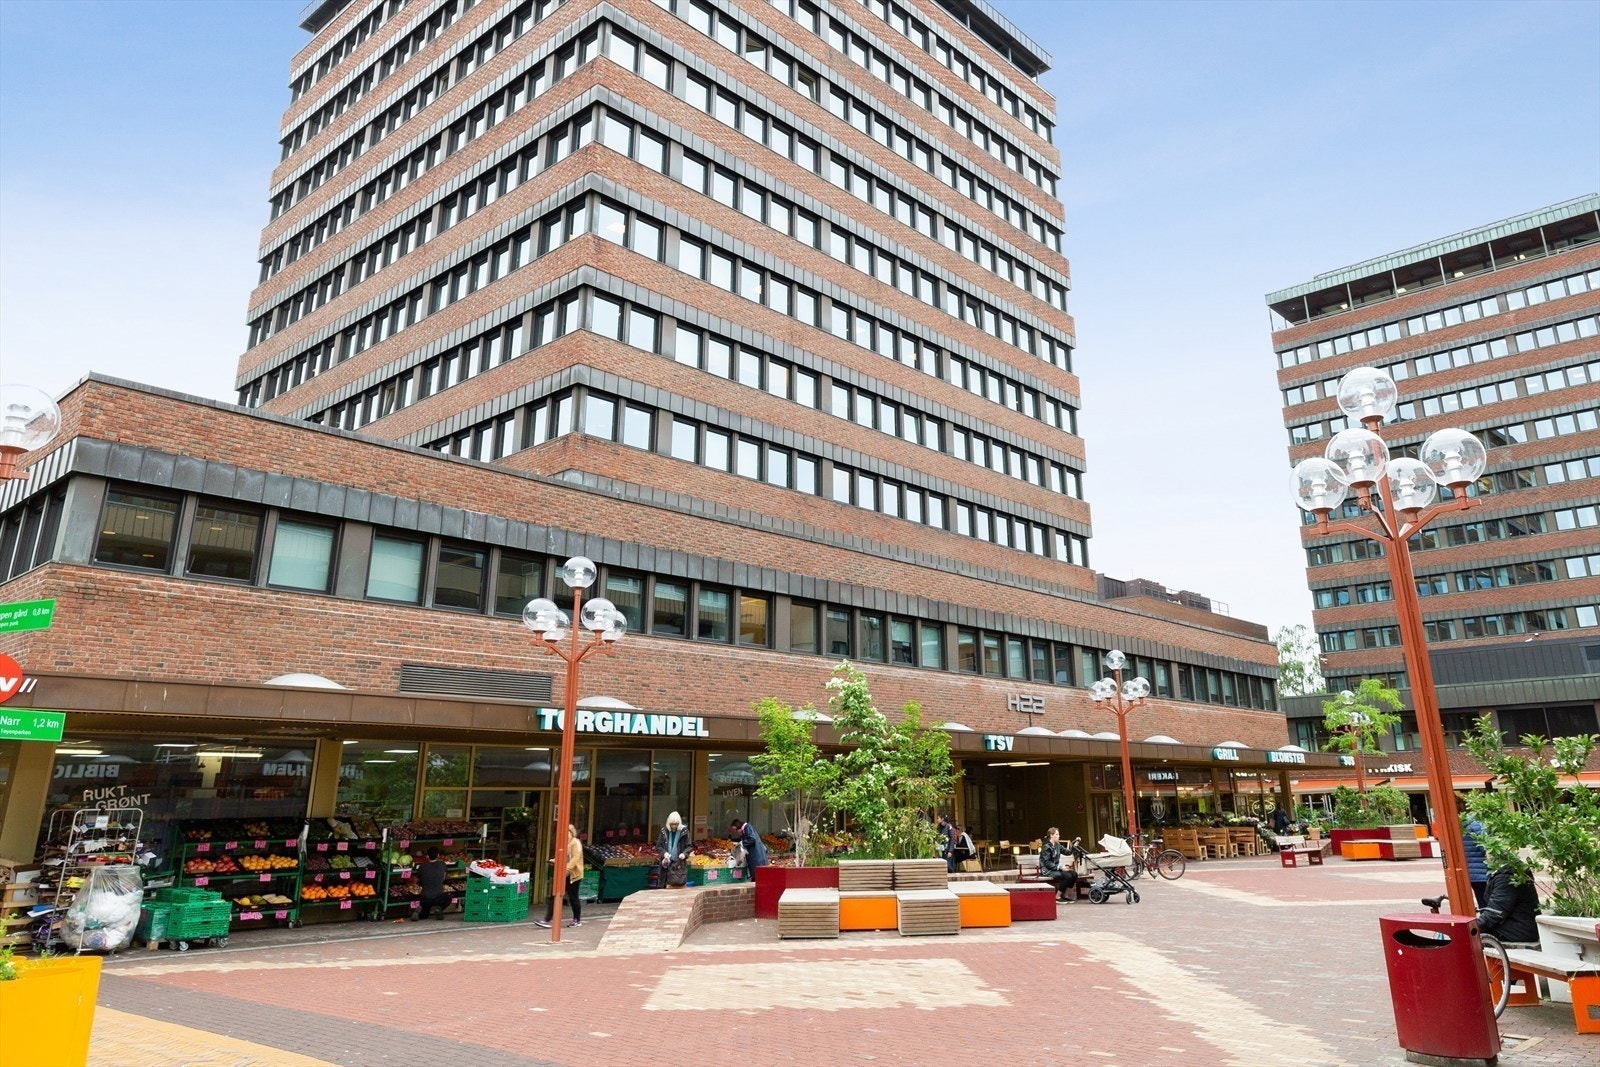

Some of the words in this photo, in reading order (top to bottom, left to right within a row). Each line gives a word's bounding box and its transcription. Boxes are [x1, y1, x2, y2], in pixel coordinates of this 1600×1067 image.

[13, 608, 28, 620] gård
[1007, 692, 1045, 714] H22
[33, 718, 45, 728] 1,2
[46, 719, 59, 728] km
[985, 734, 1014, 751] TSV
[1214, 748, 1239, 760] GRILL
[1269, 751, 1306, 764] BLOMSTER
[95, 793, 151, 810] GRØNT
